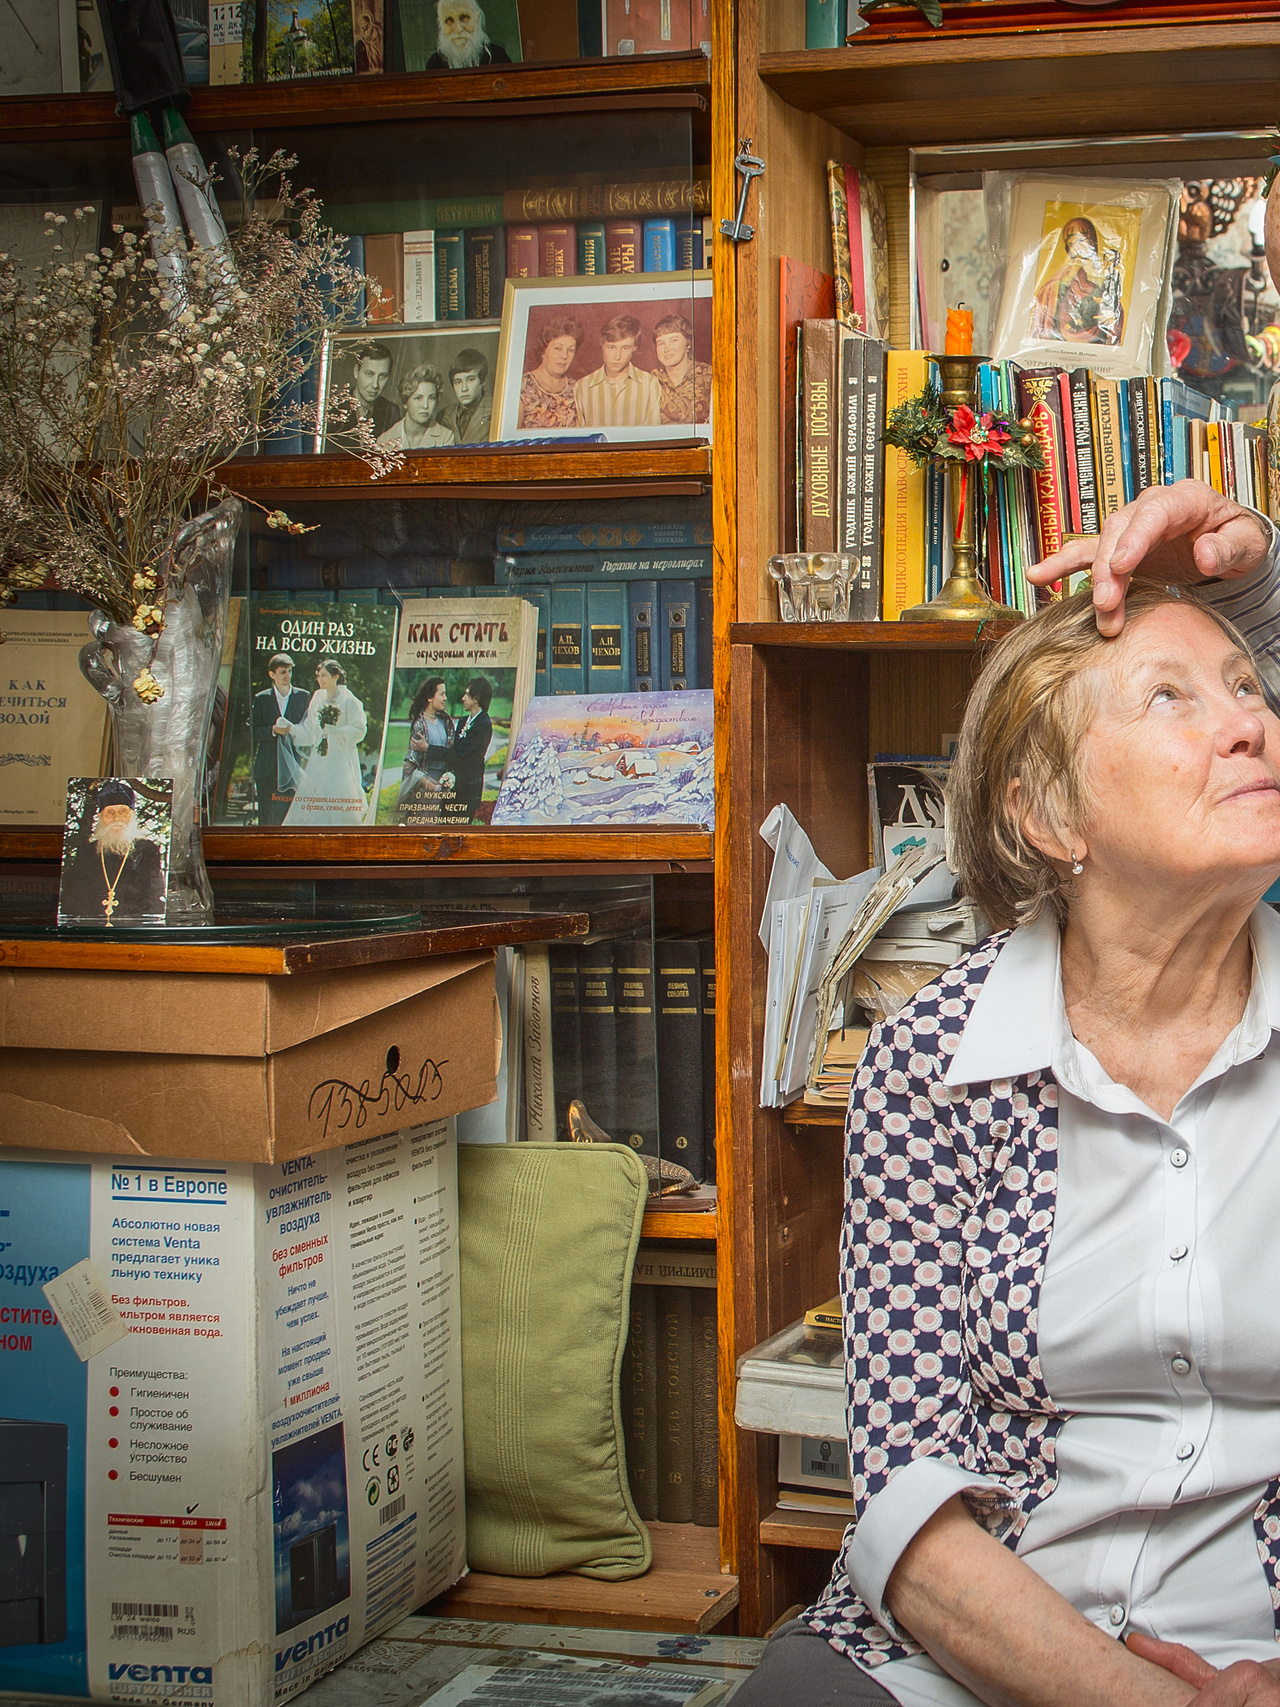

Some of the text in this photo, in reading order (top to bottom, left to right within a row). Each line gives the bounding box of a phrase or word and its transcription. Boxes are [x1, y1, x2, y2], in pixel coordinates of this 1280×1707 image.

[1136, 390, 1146, 450] ПРАВОСЛАВИЕ
[811, 446, 830, 518] ДУХОВНЫЕ
[601, 558, 705, 572] Гадание на иероглифах
[281, 620, 354, 637] ОДИН РАЗ
[408, 622, 509, 643] КАК СТАТЬ
[256, 636, 376, 655] НА ВСЮ ЖИЗНЬ
[9, 680, 46, 691] КАК
[408, 816, 470, 825] ПРЕДНАЗНАЧЕНИИ
[528, 977, 542, 1132] Николай Задорнов
[282, 1156, 316, 1176] VENTA-
[111, 1174, 228, 1197] № 1 в Европе
[269, 1173, 328, 1200] очиститель-
[266, 1189, 332, 1224] увлажнитель
[112, 1218, 220, 1232] Абсолютно новая
[280, 1212, 320, 1236] воздуха
[112, 1236, 200, 1249] система Venta
[272, 1234, 328, 1262] без сменных
[112, 1253, 220, 1266] предлагает уника
[278, 1252, 324, 1279] фильтров
[111, 1269, 202, 1284] льную технику
[288, 1279, 316, 1296] Ничто не
[111, 1294, 190, 1308] Без фильтров.
[286, 1310, 320, 1329] чем успех.
[281, 1331, 326, 1358] На настоящий
[278, 1346, 331, 1376] момент продано
[110, 1367, 188, 1380] Преимущества:
[287, 1366, 324, 1390] уже свыше
[130, 1388, 190, 1399] Гигиеничен
[283, 1380, 330, 1408] 1 миллиона
[130, 1406, 188, 1418] Простое об
[272, 1394, 342, 1431] воздухоочистителей-
[130, 1422, 192, 1432] служивание
[270, 1408, 344, 1450] увлажнителей VENTA.
[130, 1439, 188, 1450] Несложное
[130, 1453, 188, 1464] устройство
[130, 1471, 182, 1484] Бесшумен
[668, 1472, 682, 1484] 18
[177, 1627, 196, 1636] RUS
